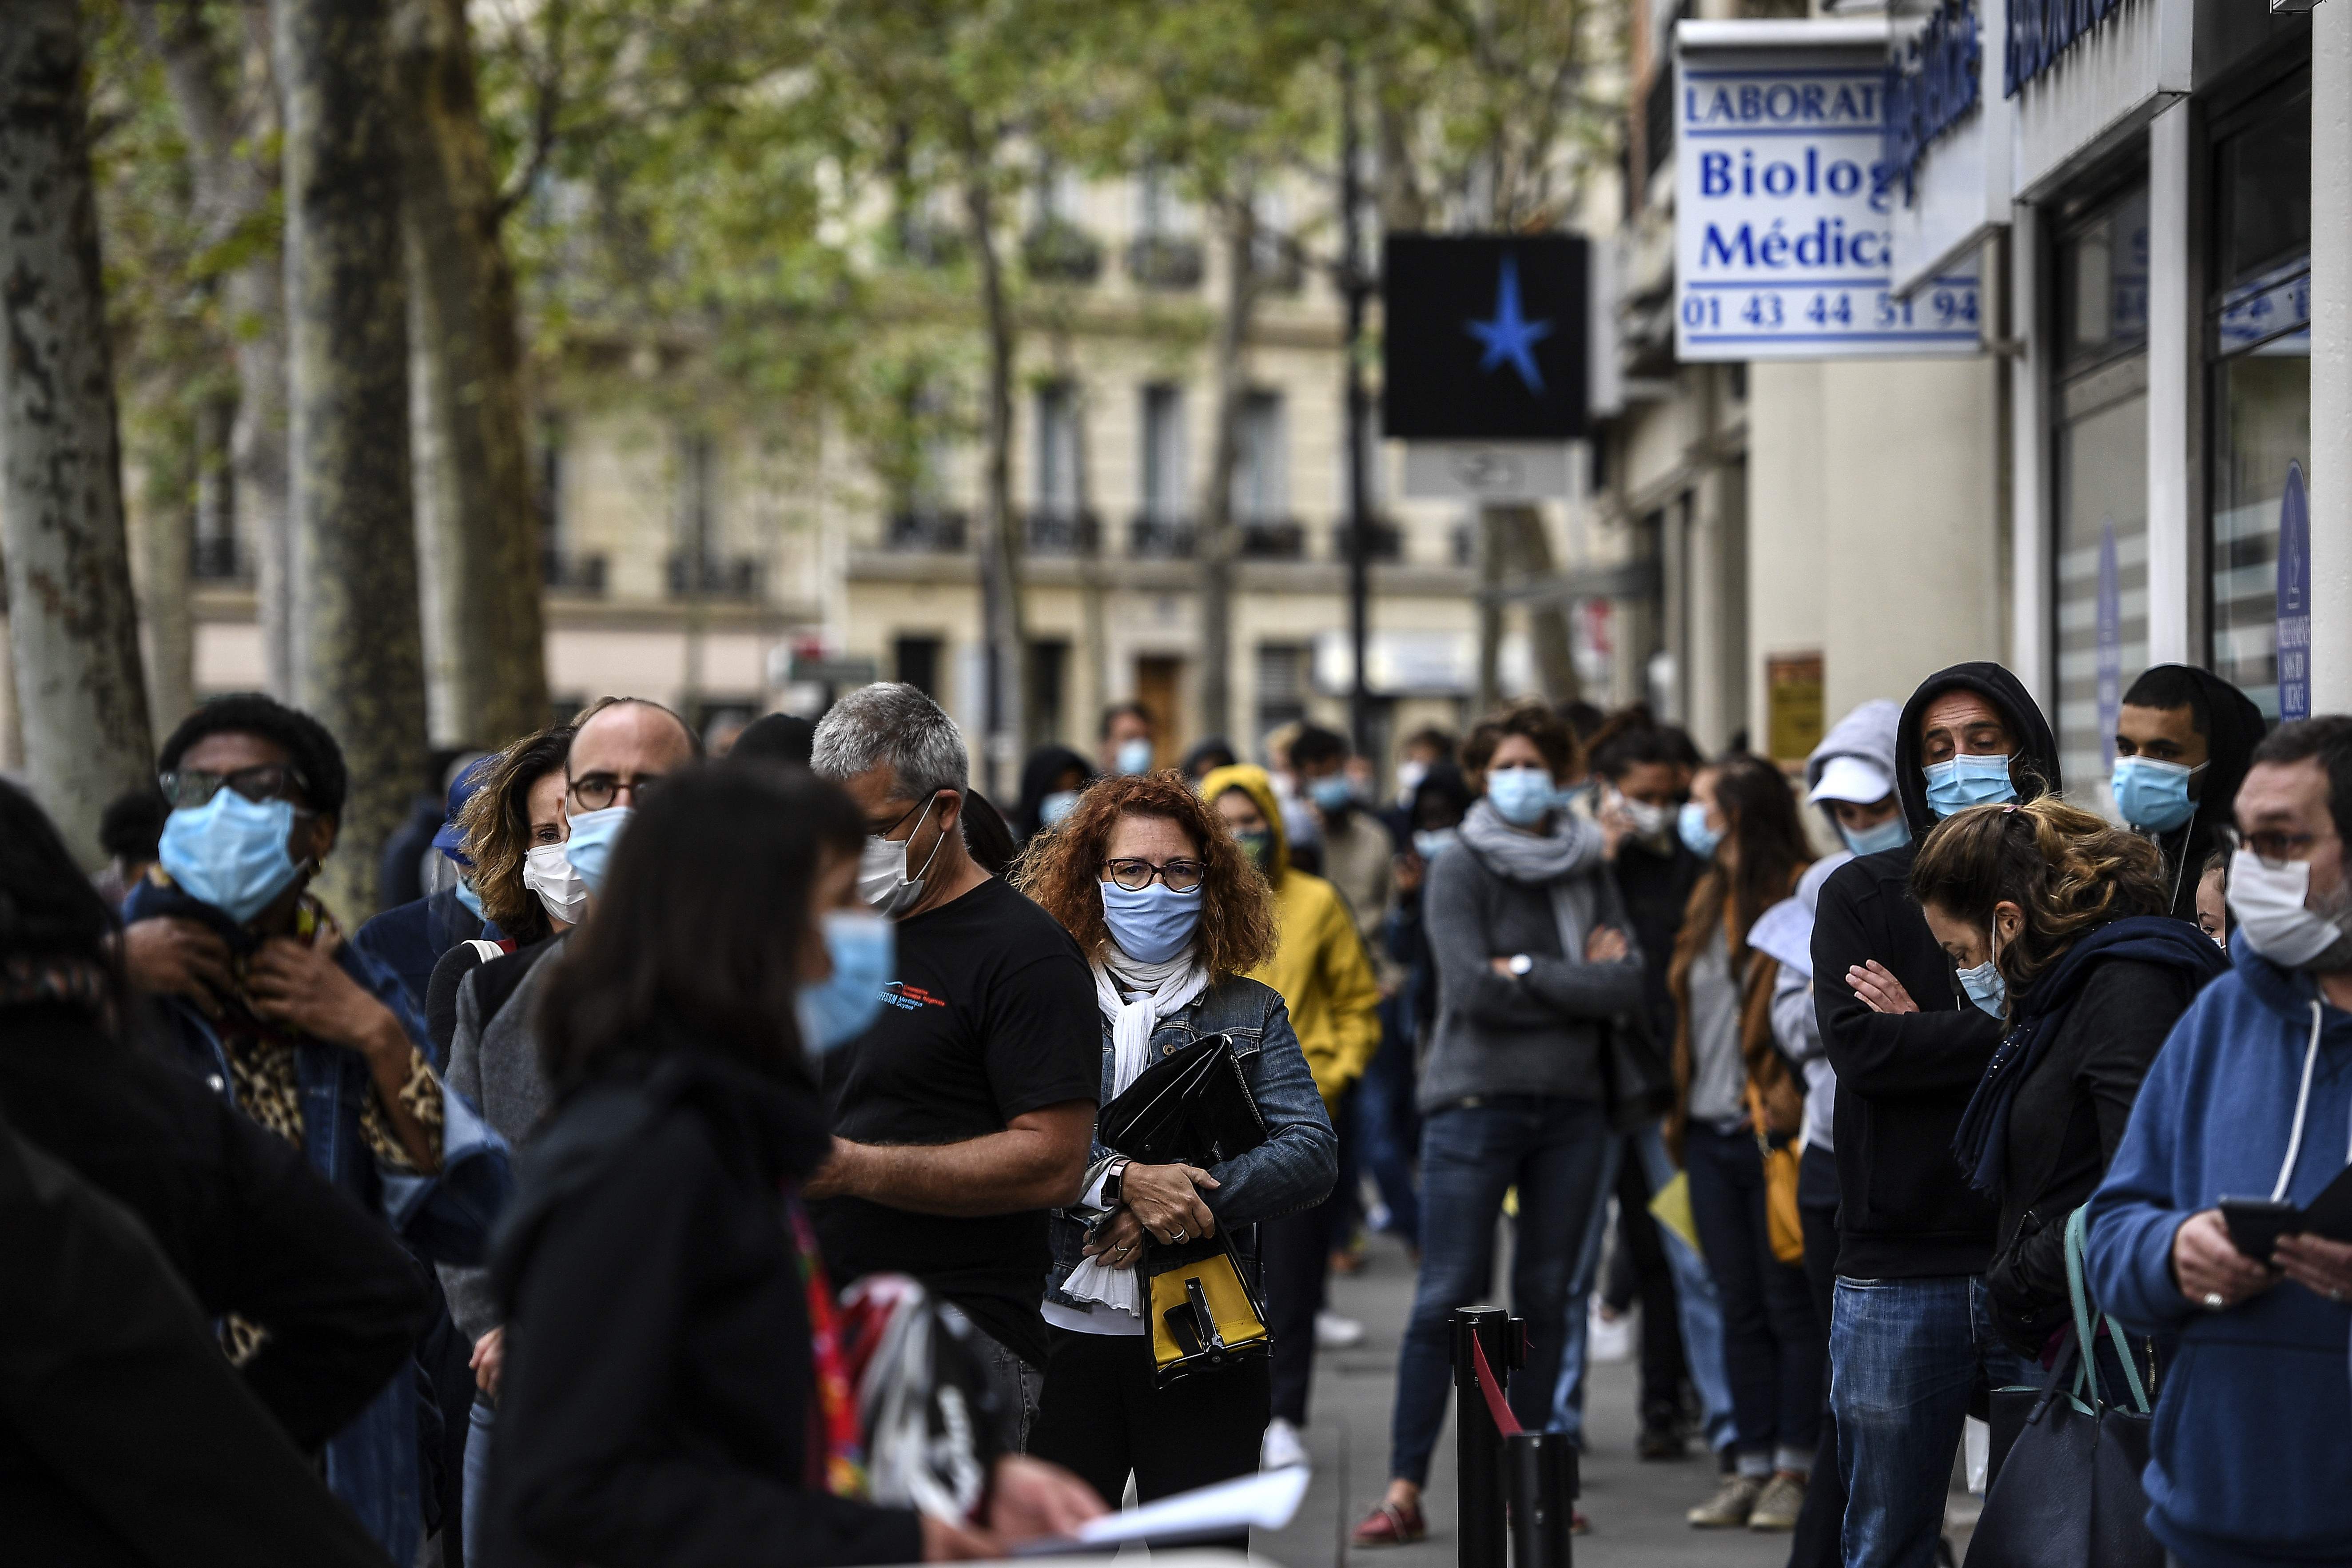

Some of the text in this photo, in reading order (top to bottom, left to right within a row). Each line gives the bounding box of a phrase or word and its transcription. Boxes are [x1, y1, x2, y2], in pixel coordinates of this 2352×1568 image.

[1685, 83, 1882, 123] LABORAT
[1701, 146, 1891, 214] Biolog
[1684, 287, 1979, 327] 01 43 44 51 94
